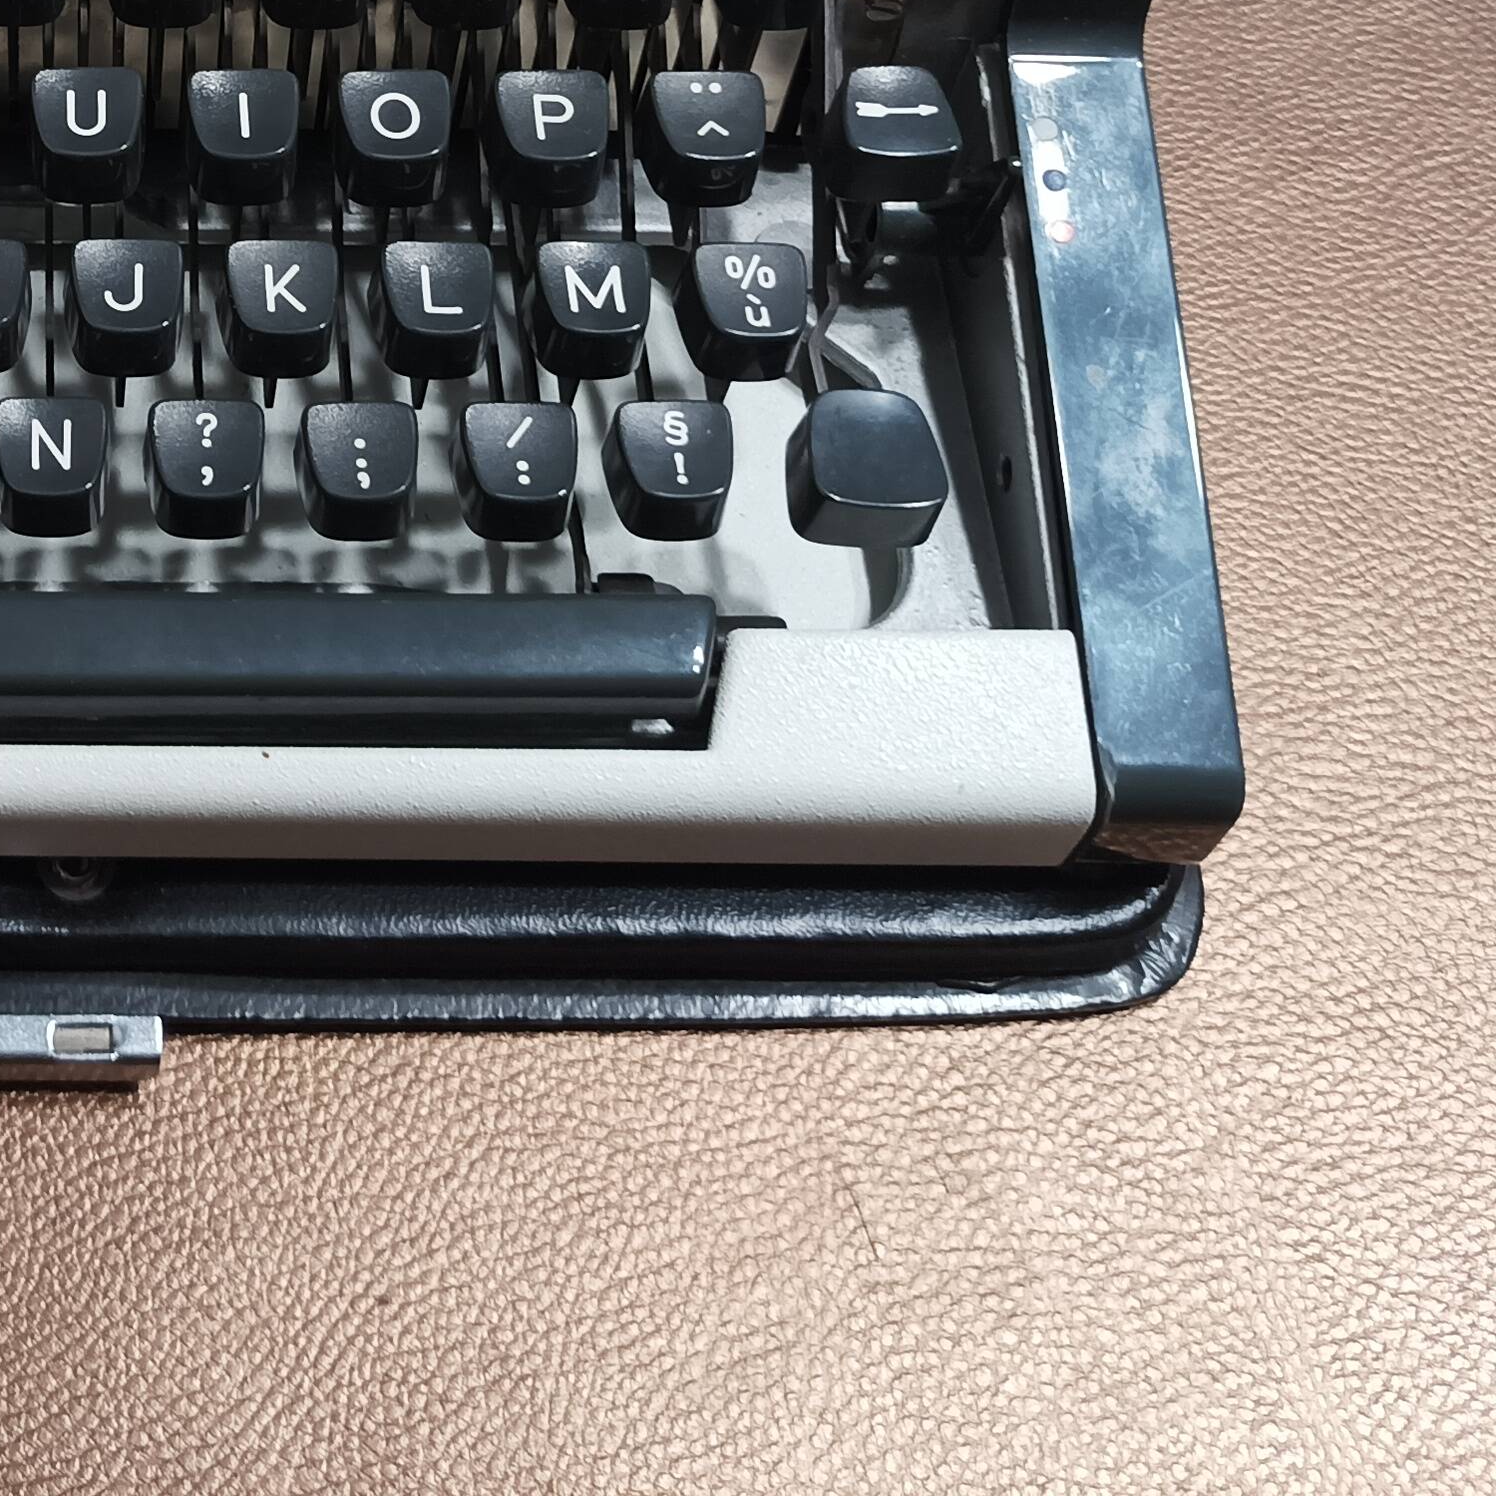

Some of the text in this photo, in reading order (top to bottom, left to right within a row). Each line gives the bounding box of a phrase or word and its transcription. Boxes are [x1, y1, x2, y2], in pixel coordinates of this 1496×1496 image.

[66, 89, 107, 137] U
[238, 92, 250, 139] I
[370, 92, 421, 140] O
[532, 93, 575, 141] P
[100, 260, 144, 312] J
[263, 263, 307, 313] K
[418, 262, 464, 315] L
[564, 263, 627, 314] M
[724, 251, 777, 291] %
[744, 293, 772, 328] ù
[31, 418, 72, 471] N
[195, 412, 218, 448] ?
[660, 407, 689, 446] §
[673, 452, 689, 485] !
